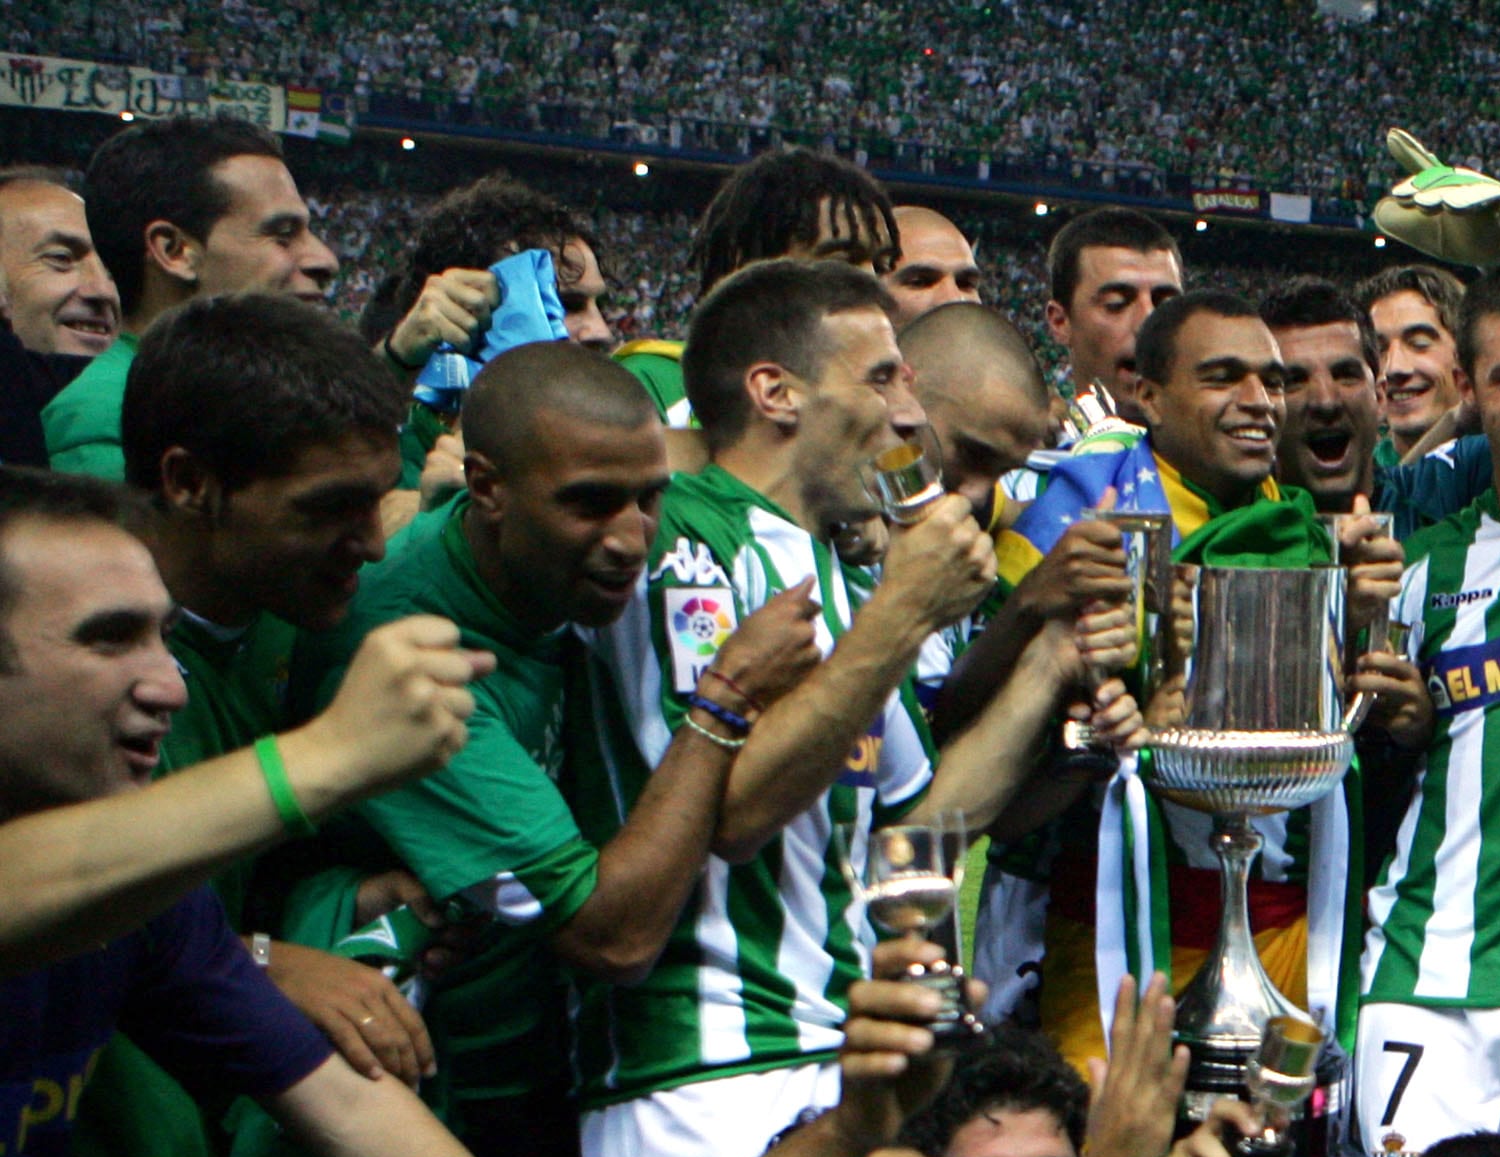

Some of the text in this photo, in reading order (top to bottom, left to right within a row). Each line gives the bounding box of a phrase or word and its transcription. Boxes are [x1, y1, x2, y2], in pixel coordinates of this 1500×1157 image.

[1430, 586, 1493, 609] Kappa
[1446, 666, 1481, 702] EL
[1380, 1041, 1425, 1127] 7
